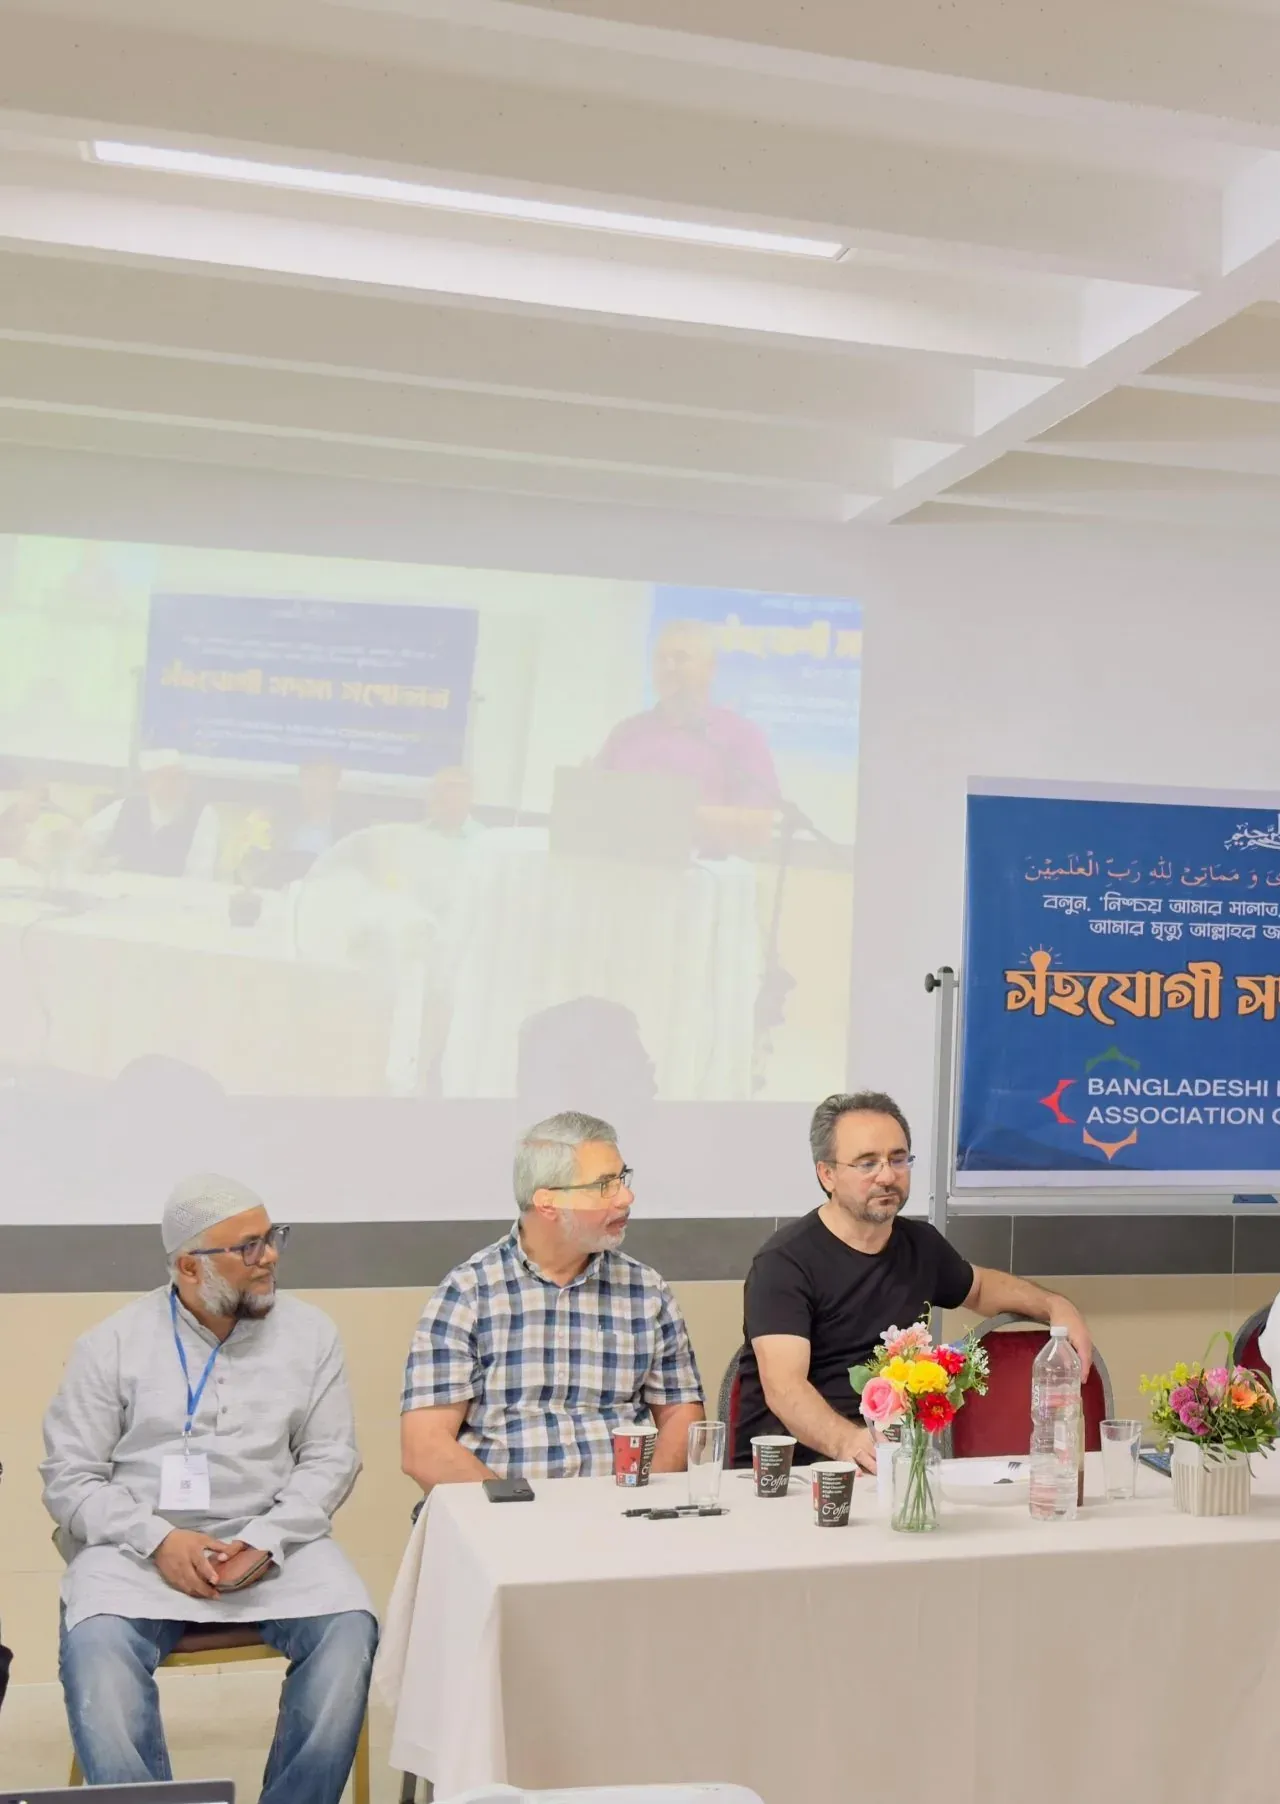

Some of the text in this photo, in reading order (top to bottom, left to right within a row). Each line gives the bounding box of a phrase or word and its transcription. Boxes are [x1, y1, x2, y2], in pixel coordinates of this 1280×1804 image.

[1169, 899, 1222, 916] আমার
[1088, 919, 1145, 936] আমার
[1150, 921, 1183, 942] মৃত্যু
[1189, 922, 1256, 941] আল্লাহর
[1087, 1077, 1268, 1098] BANGLADESHI
[1086, 1105, 1265, 1126] ASSOCIATION
